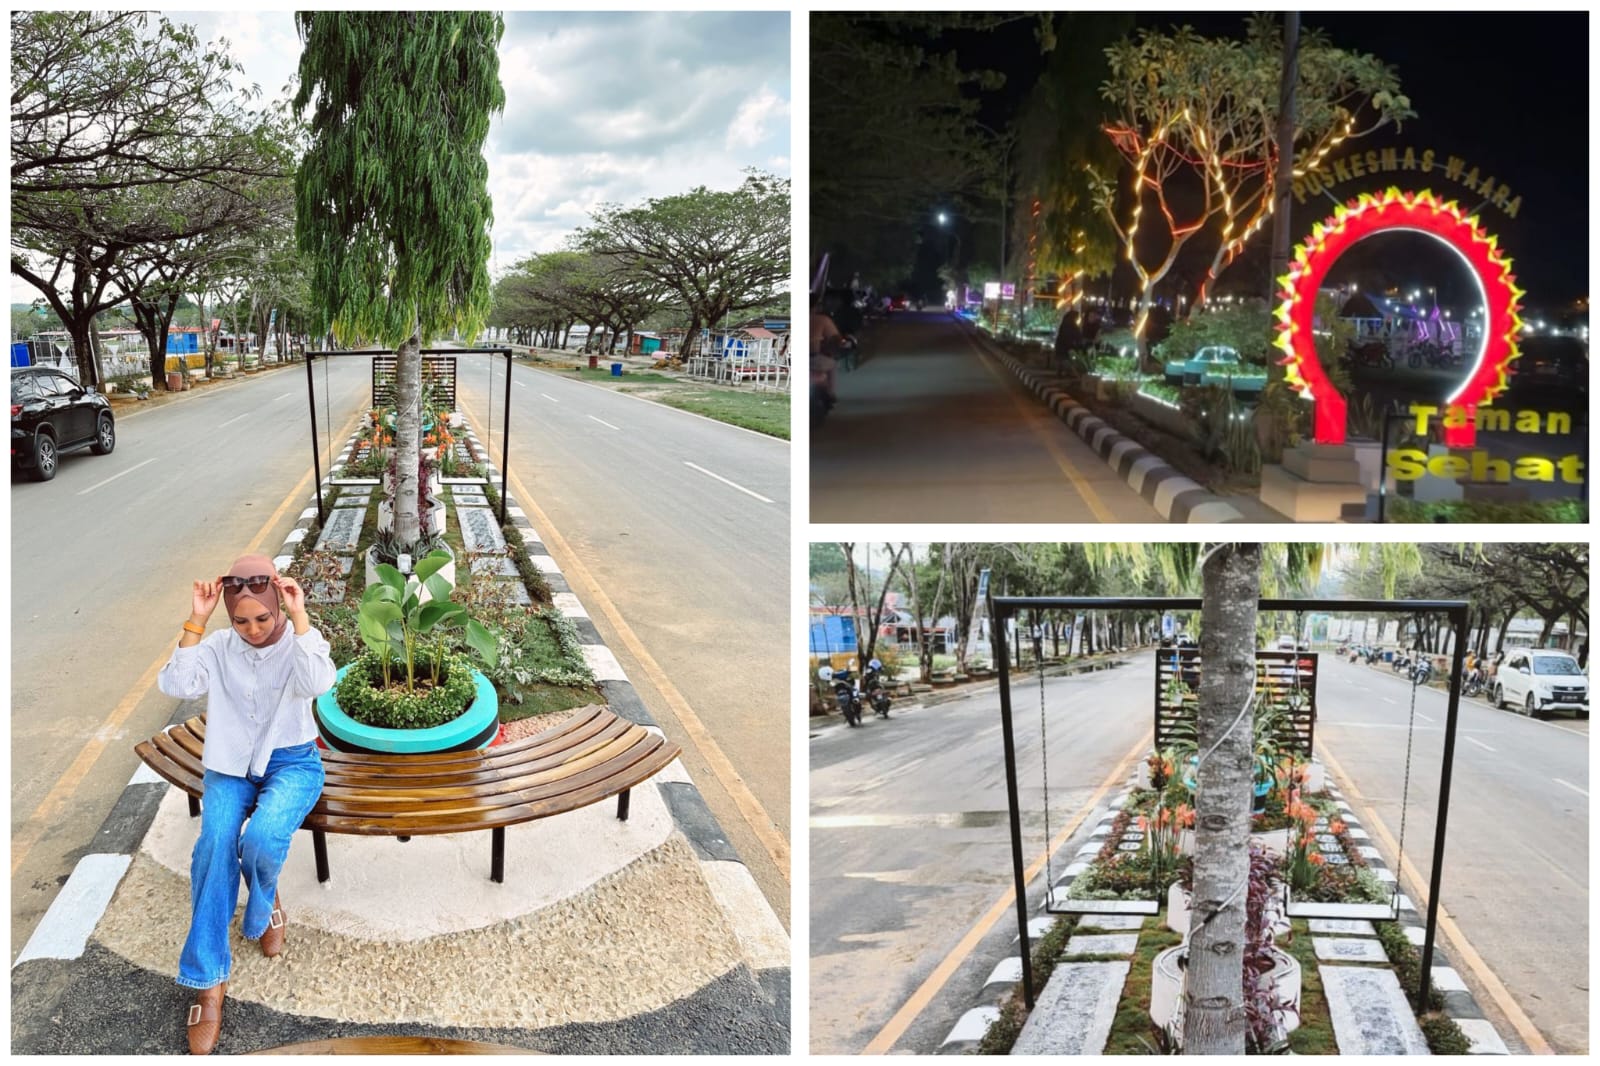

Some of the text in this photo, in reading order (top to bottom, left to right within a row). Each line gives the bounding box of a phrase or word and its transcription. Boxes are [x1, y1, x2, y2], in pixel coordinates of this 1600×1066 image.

[1292, 147, 1522, 218] PUSKESMAS WAARA
[1409, 404, 1571, 436] Taman
[1386, 448, 1584, 483] Sehat
